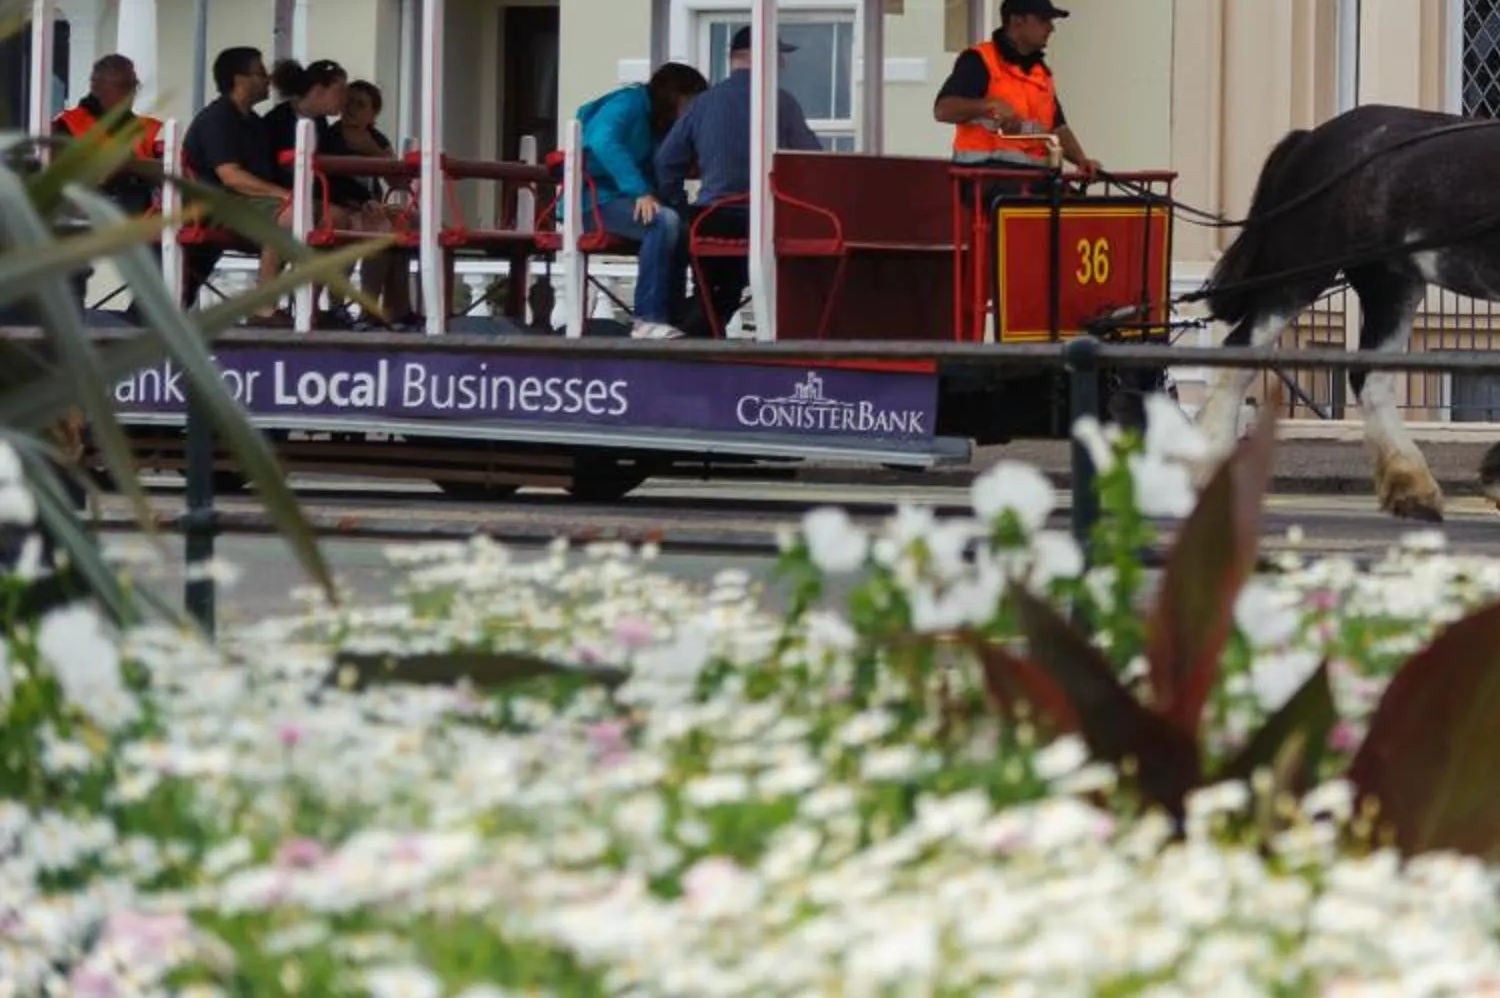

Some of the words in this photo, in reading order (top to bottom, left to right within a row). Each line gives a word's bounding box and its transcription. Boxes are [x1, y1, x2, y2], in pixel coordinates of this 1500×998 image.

[1076, 237, 1109, 284] 36
[113, 357, 187, 403] ank
[208, 355, 261, 404] or
[274, 359, 389, 407] Local
[402, 362, 628, 416] Businesses
